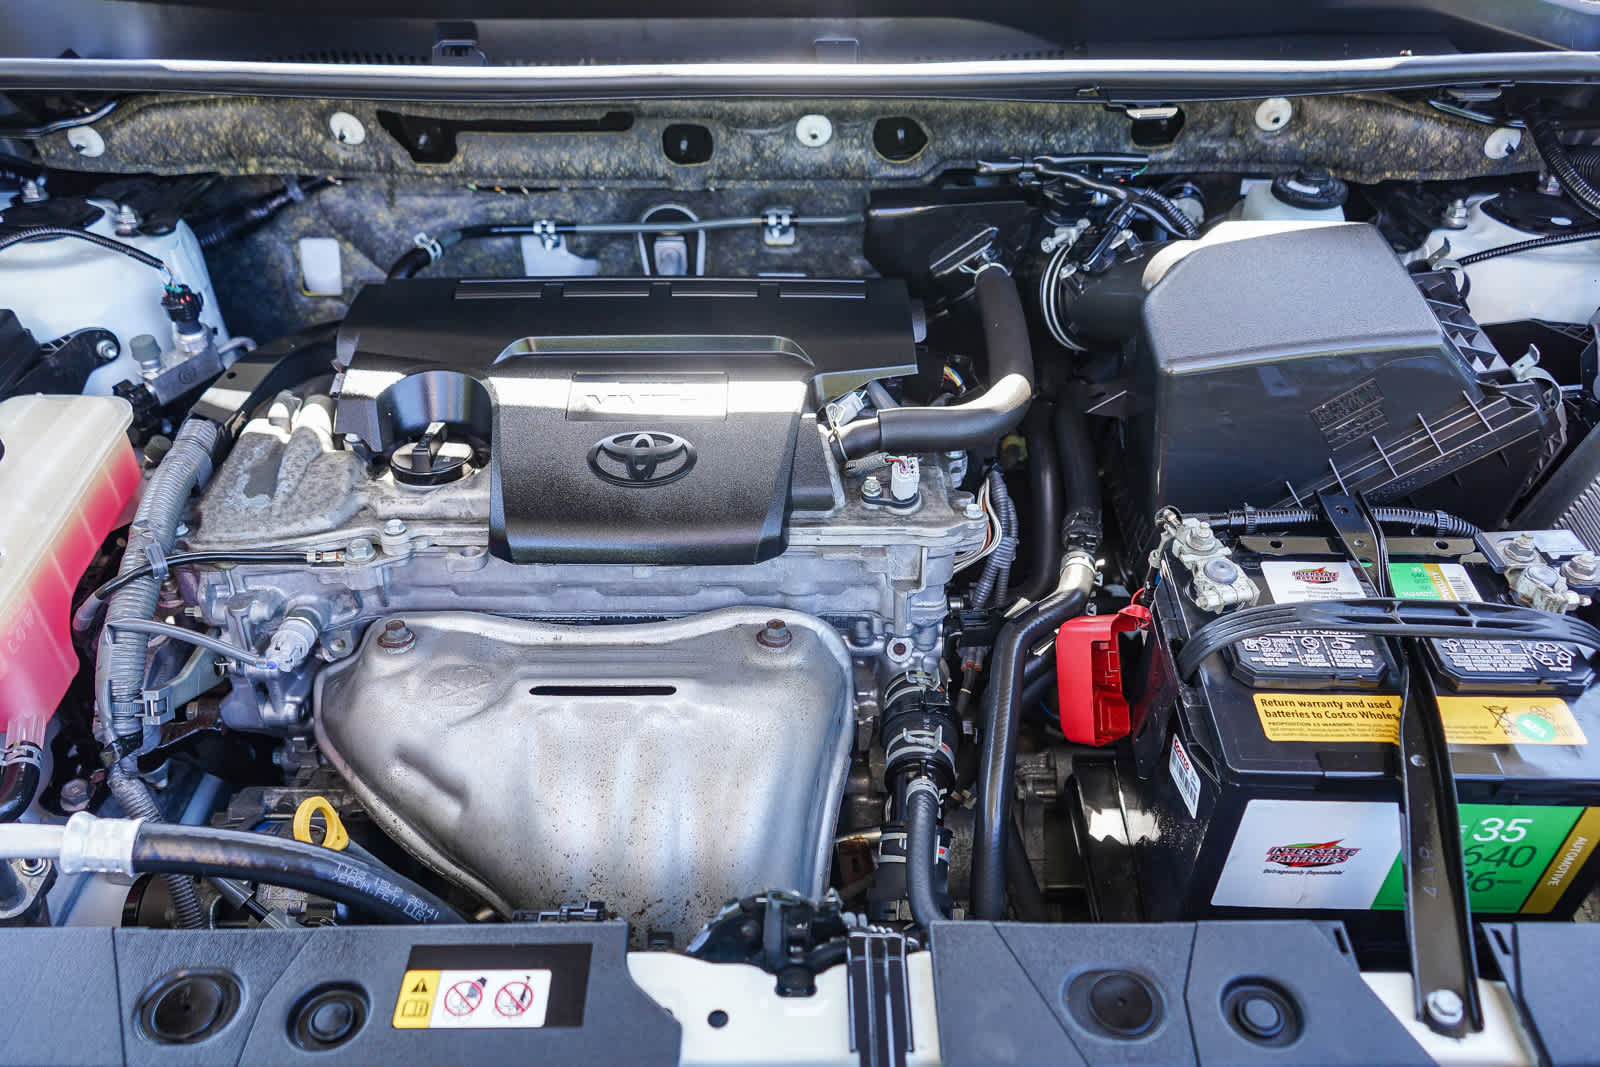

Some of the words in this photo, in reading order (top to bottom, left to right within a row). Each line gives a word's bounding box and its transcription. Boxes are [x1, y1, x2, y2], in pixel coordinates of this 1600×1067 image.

[1260, 699, 1296, 708] Return
[1298, 701, 1343, 710] warranty
[1346, 700, 1365, 708] and
[1367, 700, 1392, 709] used
[1264, 709, 1310, 719] batteries
[1312, 711, 1322, 719] to
[1324, 710, 1358, 719] Costco
[1473, 817, 1533, 842] 35
[1270, 848, 1359, 856] INTERSTATE
[1270, 855, 1346, 863] BATTERIES
[1547, 836, 1588, 887] AUTOMOTIVE
